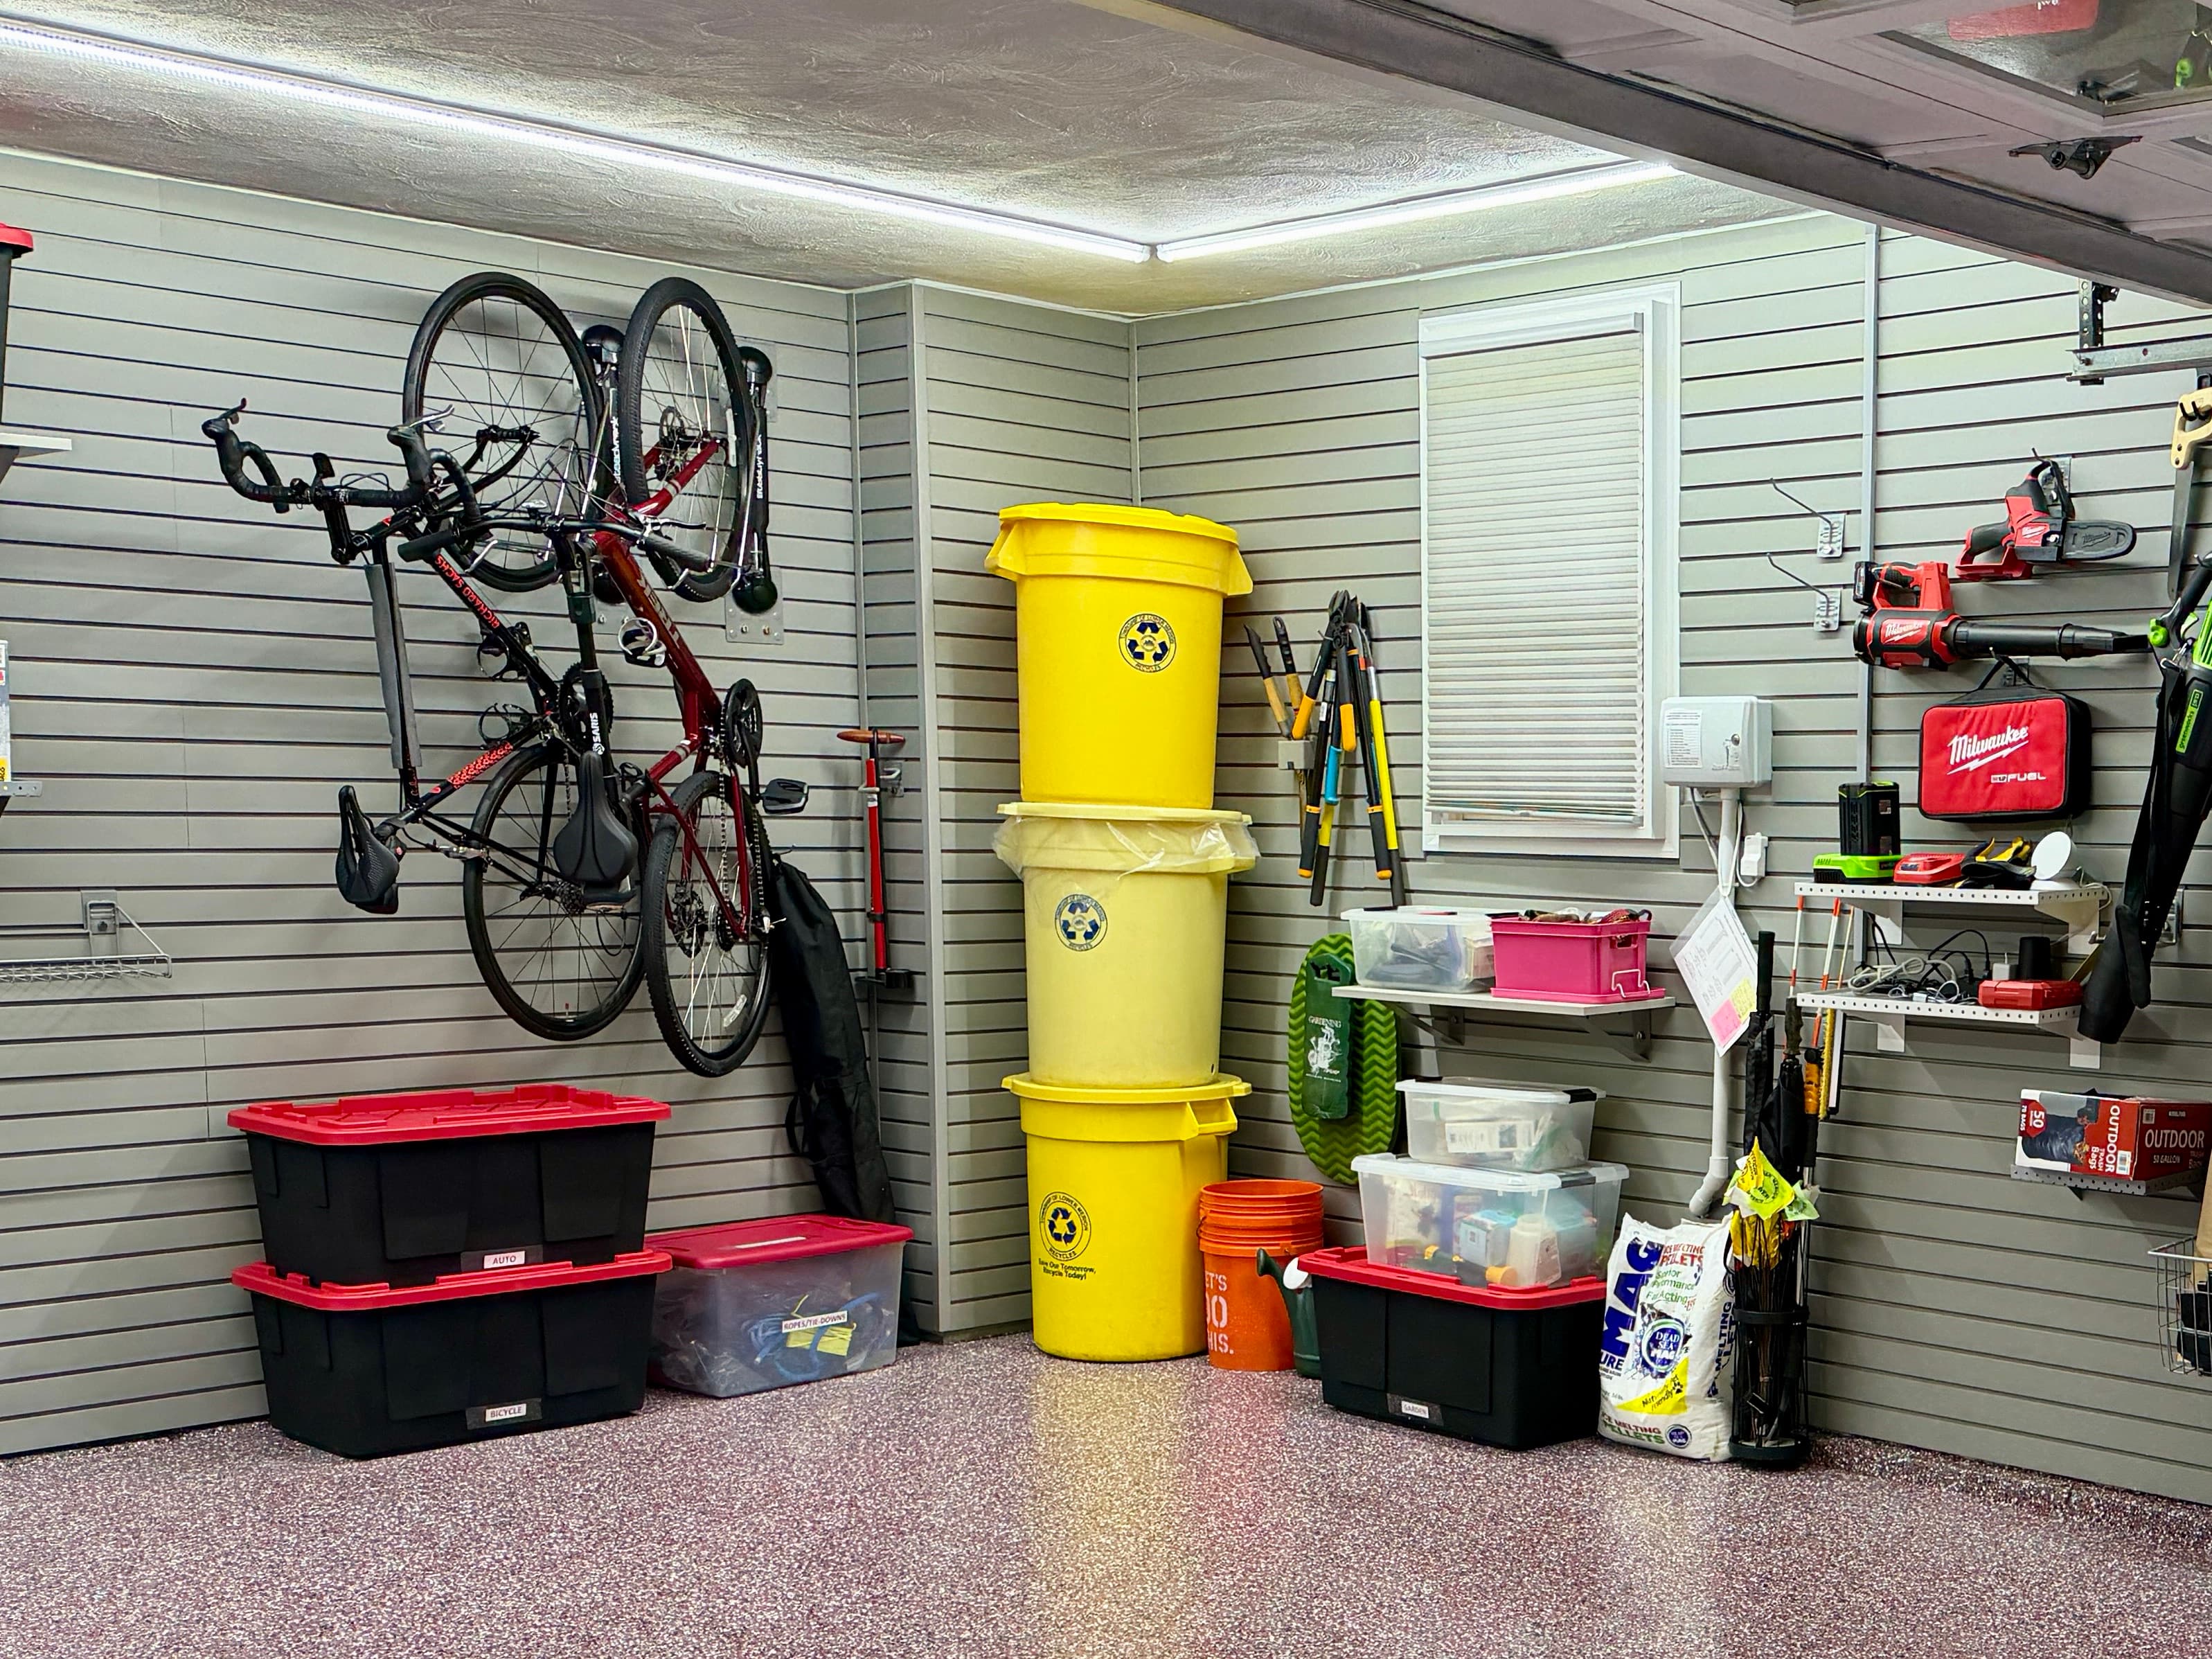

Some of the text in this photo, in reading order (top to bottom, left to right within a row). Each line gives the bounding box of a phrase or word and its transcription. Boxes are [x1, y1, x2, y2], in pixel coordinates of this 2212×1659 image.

[435, 555, 500, 630] RICHARD SACHS
[1947, 725, 2029, 765] Milwaukee
[2008, 772, 2046, 783] FUEL
[2033, 1110, 2045, 1128] 50
[2105, 1105, 2121, 1173] OUTDOOR
[2145, 1129, 2205, 1148] OUTDOOR
[492, 1255, 517, 1265] AUTO
[1205, 1271, 1227, 1292] ET'S
[1601, 1236, 1664, 1359] MAG
[1208, 1331, 1234, 1355] HIS.
[1656, 1331, 1680, 1342] DEAD
[1658, 1340, 1674, 1351] SEA
[1715, 1302, 1732, 1372] MELTING
[1601, 1350, 1625, 1373] URE
[490, 1405, 522, 1418] BICYCLE
[1614, 1419, 1662, 1435] MELTING
